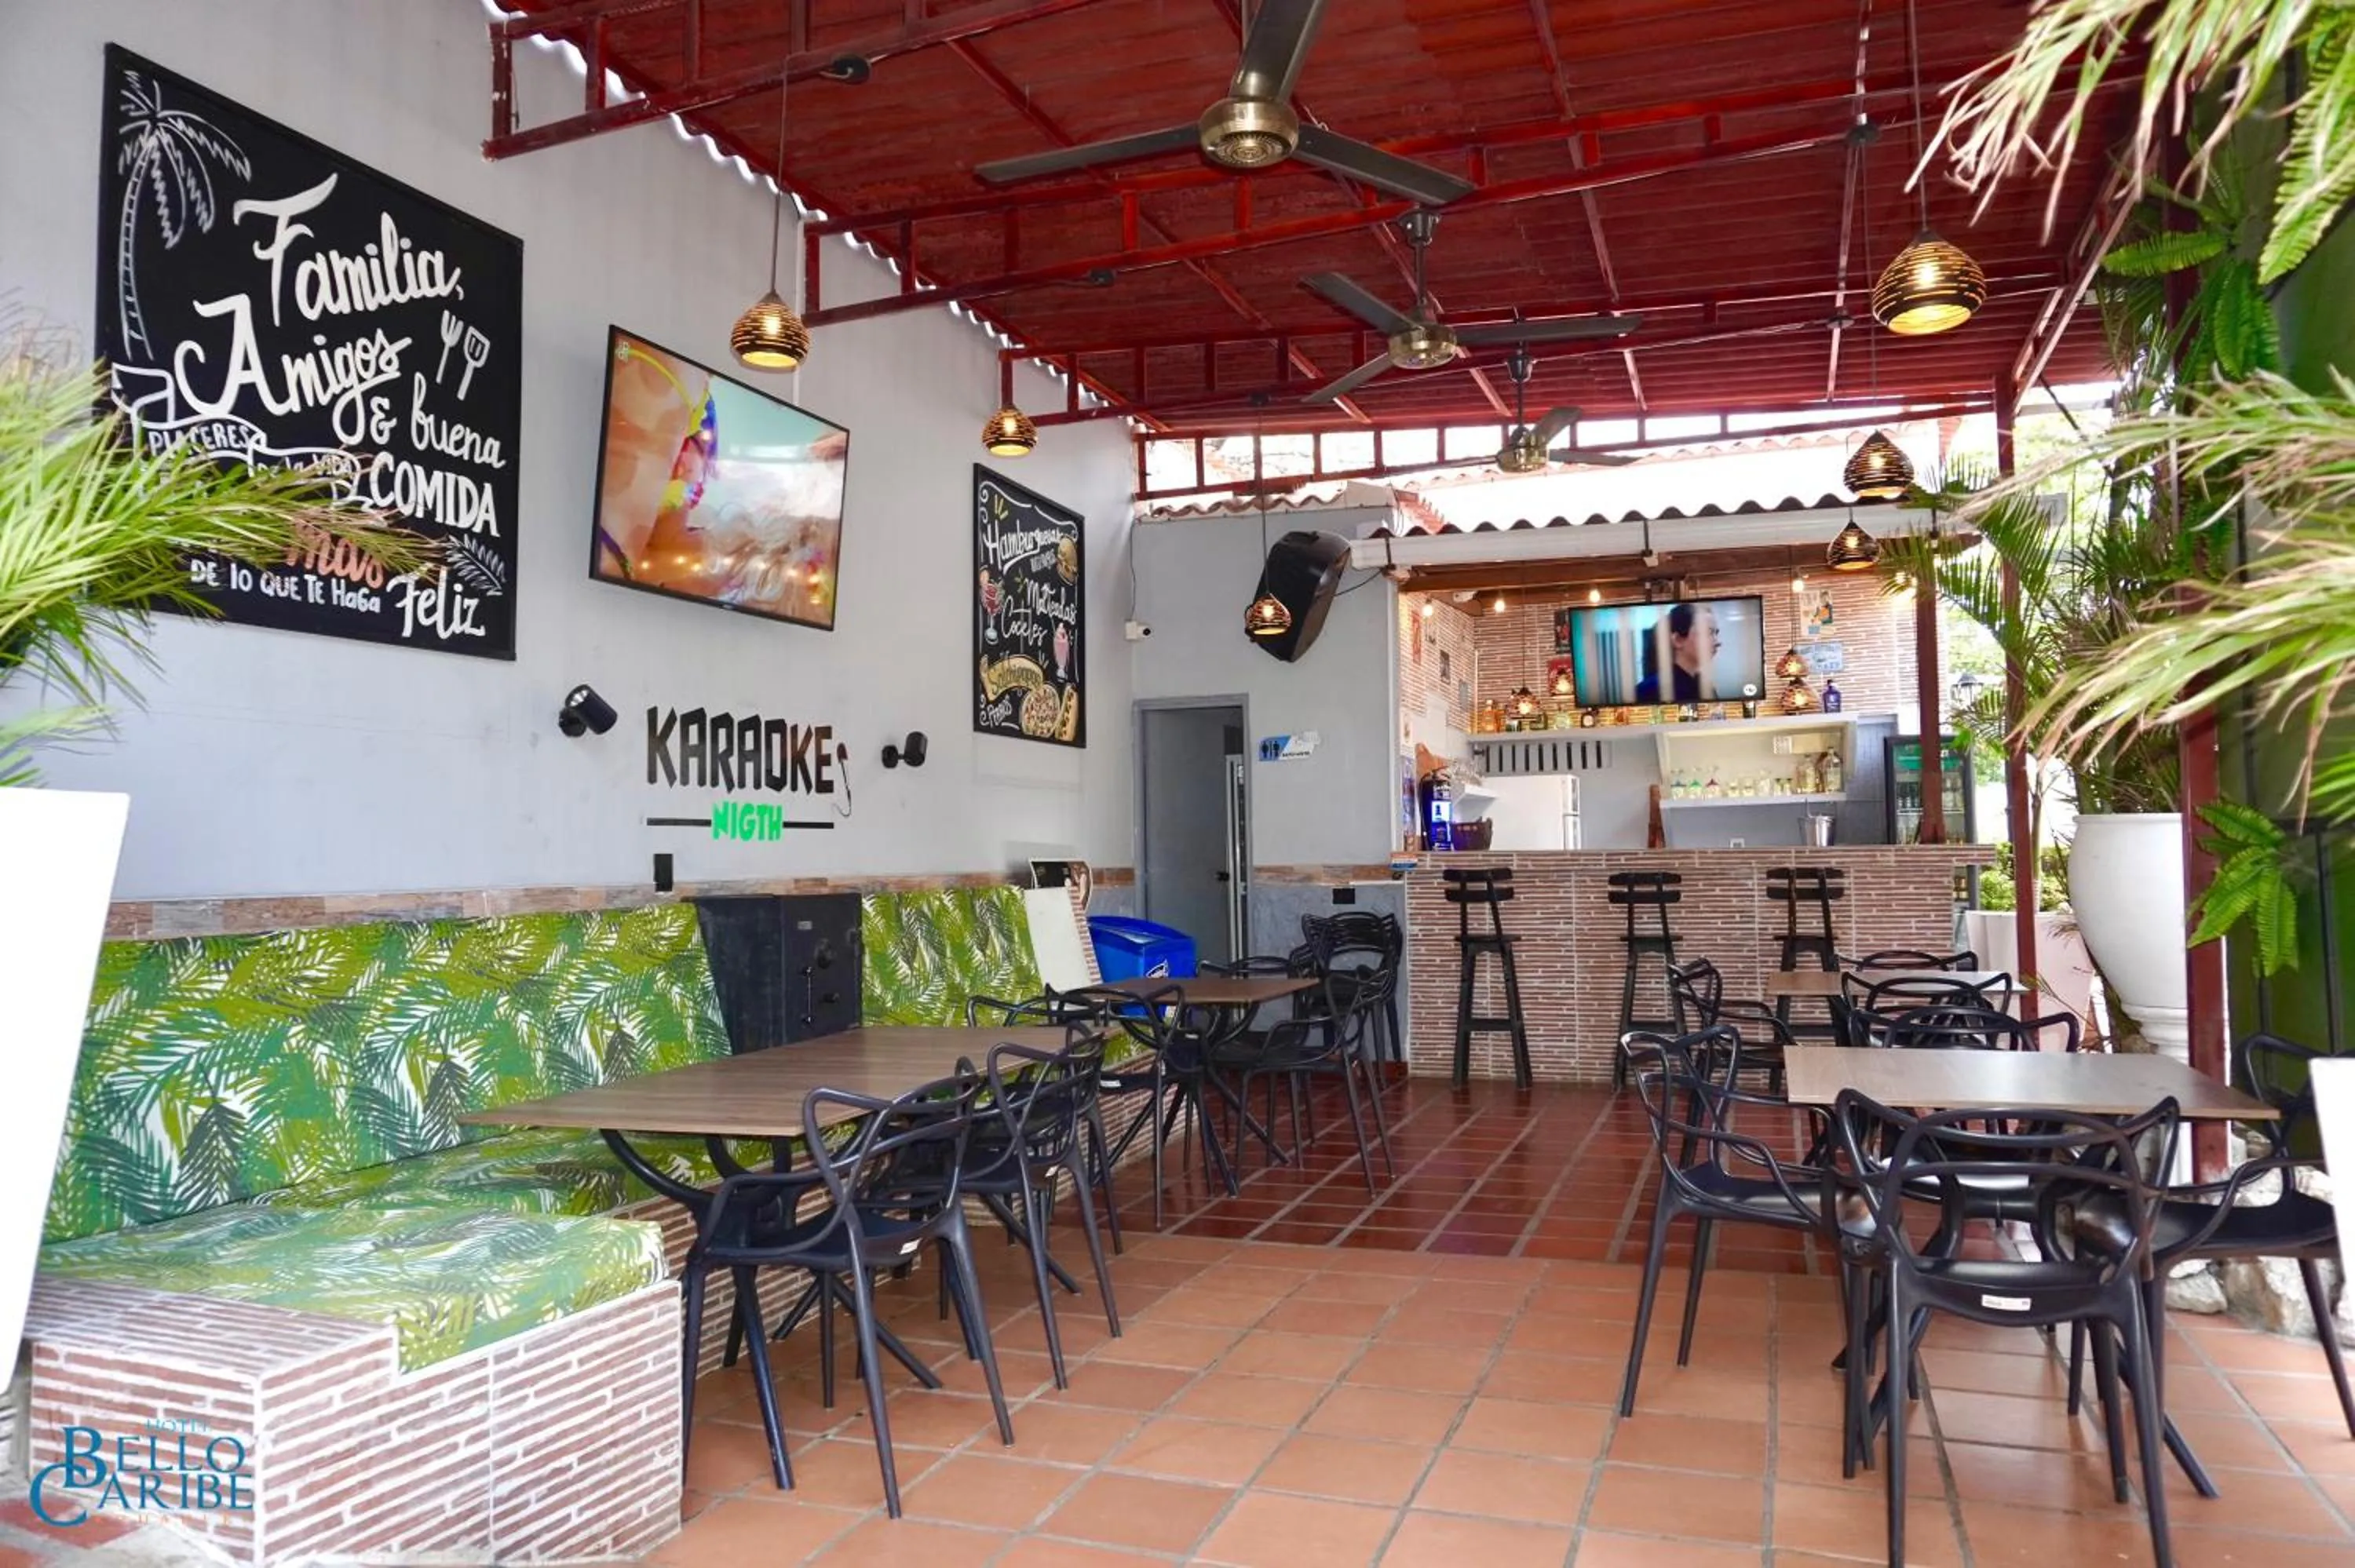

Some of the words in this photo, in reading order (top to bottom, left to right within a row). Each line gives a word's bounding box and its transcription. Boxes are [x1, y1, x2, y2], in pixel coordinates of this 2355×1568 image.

[233, 172, 465, 326] Familia,
[173, 293, 412, 445] Amigos
[411, 371, 506, 469] buena
[369, 450, 501, 538] COMIDA
[190, 558, 221, 587] DE
[260, 571, 303, 601] QUE
[385, 564, 486, 640] Feliz
[647, 706, 834, 796] KARAOKE
[712, 801, 783, 842] NIGTH
